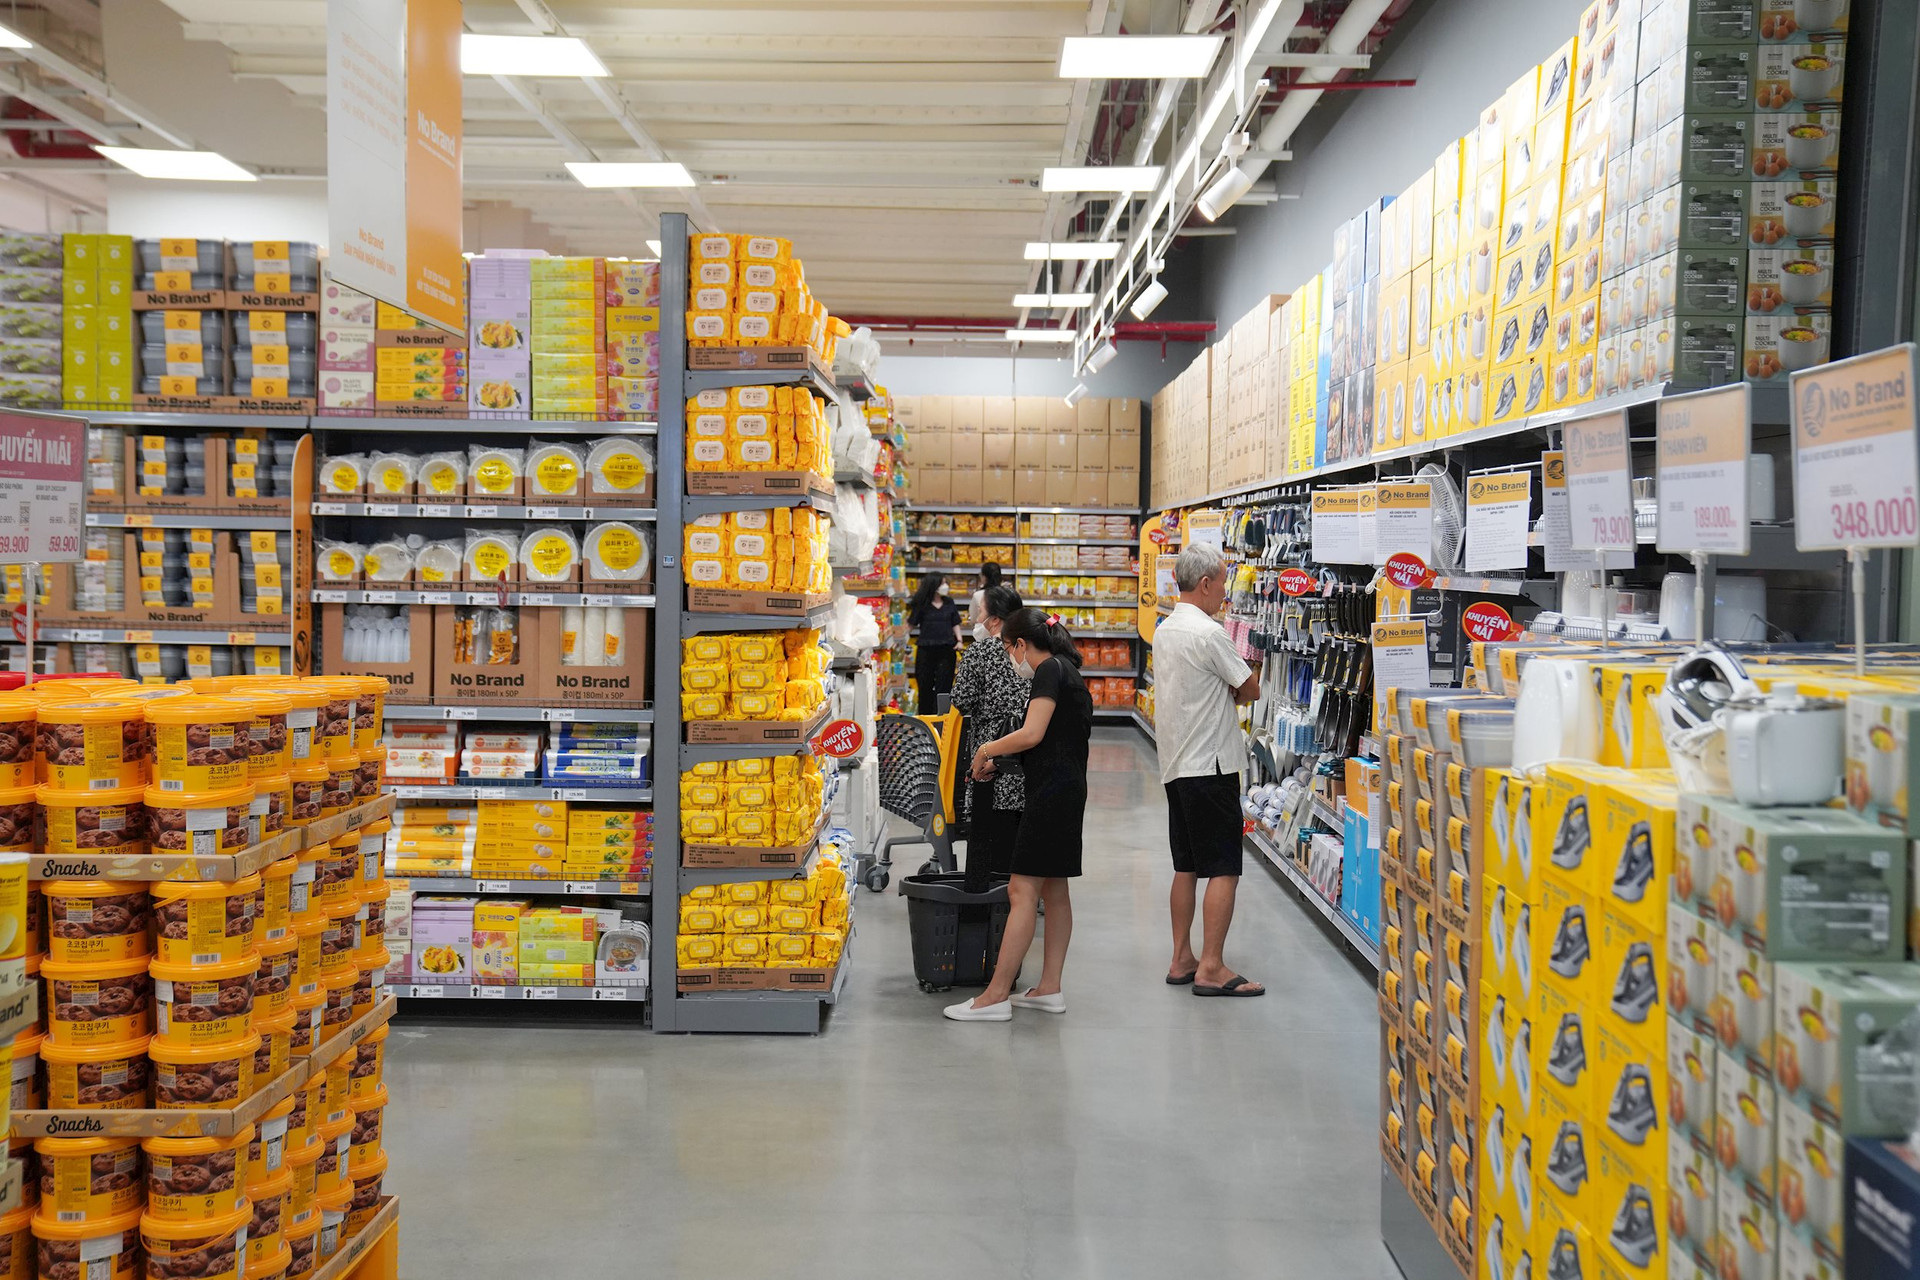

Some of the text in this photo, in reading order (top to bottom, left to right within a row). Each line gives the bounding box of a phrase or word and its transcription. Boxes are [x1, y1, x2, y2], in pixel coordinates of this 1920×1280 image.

[418, 110, 430, 138] No
[432, 120, 455, 156] Brand
[148, 293, 211, 304] No Brand
[242, 295, 305, 306] No Brand
[413, 336, 444, 344] Brand
[1829, 370, 1905, 411] No Brand
[1584, 426, 1622, 449] No Brand
[0, 429, 71, 466] HUYẾN MÃI
[1502, 481, 1527, 490] Brand
[1832, 496, 1916, 539] 348.000
[1592, 516, 1631, 543] 79.900
[49, 536, 78, 552] 59.900
[1388, 560, 1424, 577] KHUYẾN
[1143, 577, 1149, 588] No
[1280, 574, 1308, 586] KHUYẾN
[1392, 570, 1411, 585] MÃI
[1285, 582, 1298, 592] MÃI
[296, 594, 301, 620] No
[149, 612, 203, 621] No Brand
[1466, 612, 1509, 631] KHUYẾN
[1472, 625, 1493, 641] MÃI
[450, 674, 524, 686] No Brand
[556, 676, 630, 688] No Brand
[562, 691, 581, 699] 종이컵
[822, 723, 856, 747] KHUYẾN
[835, 738, 852, 753] MÃI
[346, 813, 362, 830] Snacks
[42, 860, 100, 877] Snacks
[350, 1025, 366, 1045] Snacks
[46, 1115, 104, 1134] Snacks
[348, 1238, 366, 1264] Snacks
